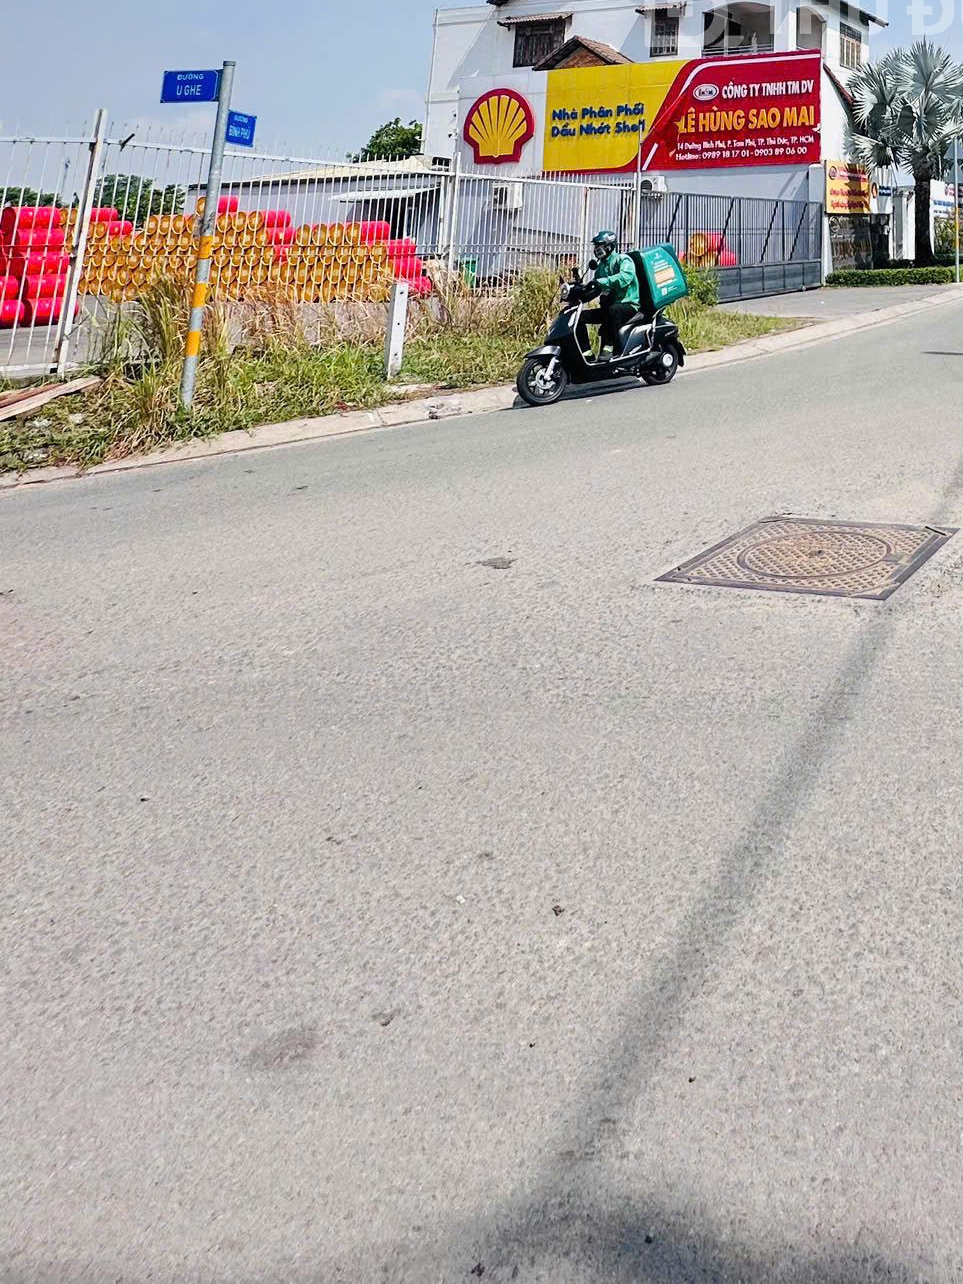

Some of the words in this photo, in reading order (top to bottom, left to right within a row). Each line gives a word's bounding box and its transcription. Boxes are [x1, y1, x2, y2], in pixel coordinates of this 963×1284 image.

[184, 84, 202, 96] GHE
[722, 81, 747, 99] CÔNG
[749, 83, 760, 97] TY
[761, 82, 787, 96] TNHH
[787, 81, 800, 95] TM
[801, 79, 814, 93] DV
[552, 108, 578, 120] Nhà
[581, 106, 613, 119] Phân
[616, 102, 644, 117] Phối
[679, 106, 696, 133] LÊ
[698, 106, 746, 132] HÙNG
[748, 107, 781, 130] SAO
[782, 105, 815, 127] MAI
[551, 122, 576, 137] Dầu
[579, 122, 611, 135] Nhớt
[799, 135, 815, 143] HCM
[702, 150, 721, 159] 0989
[722, 150, 730, 158] 18
[731, 149, 740, 157] 17
[741, 149, 750, 157] 01
[754, 148, 773, 156] 0903
[774, 147, 784, 155] 89
[786, 146, 796, 155] 06
[797, 146, 808, 154] 00
